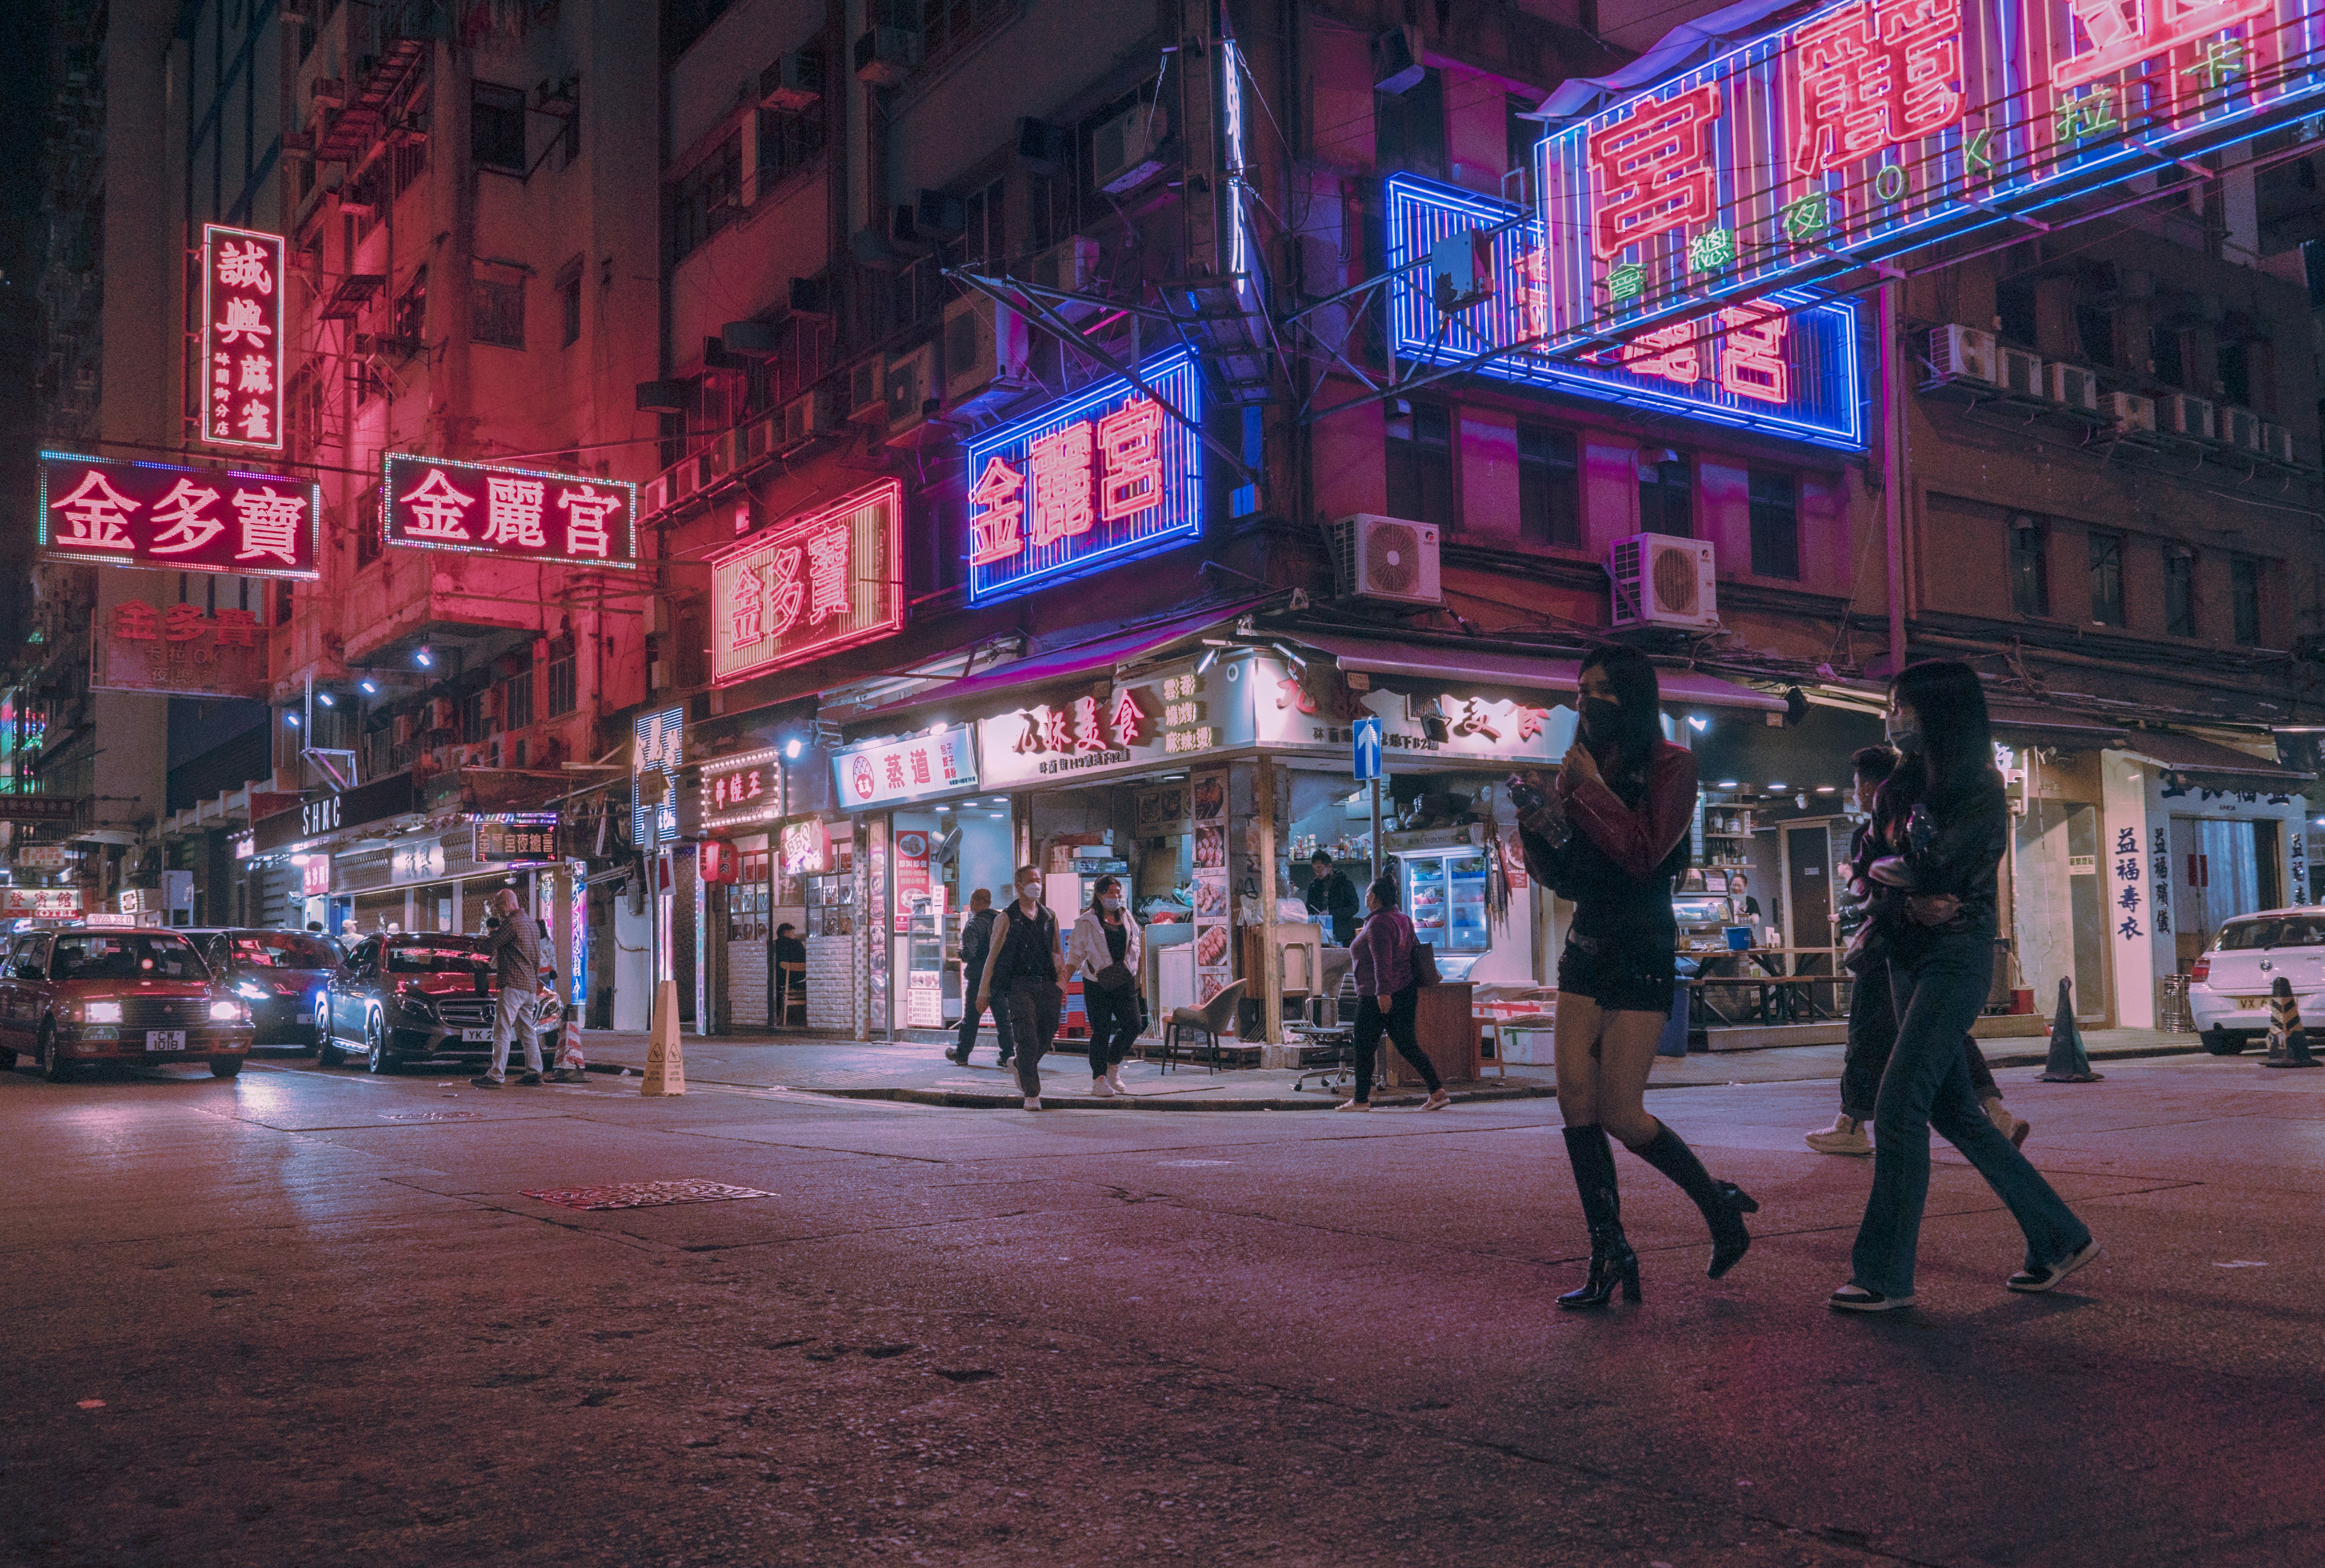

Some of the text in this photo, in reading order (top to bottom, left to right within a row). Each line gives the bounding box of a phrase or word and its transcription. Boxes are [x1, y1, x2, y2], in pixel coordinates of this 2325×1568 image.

[968, 398, 1164, 566] 金麗宮
[50, 470, 307, 564] 金多寶
[400, 469, 621, 557] 金麗宮
[729, 525, 851, 651] 金多寶
[115, 599, 255, 647] 金多寶
[884, 748, 931, 790] 蒸道
[941, 743, 952, 754] 包子
[719, 849, 730, 874] 烤肉
[2115, 827, 2144, 941] 益福壽衣
[92, 915, 132, 924] TAXI
[154, 1040, 178, 1049] 1018
[469, 1030, 482, 1039] YK
